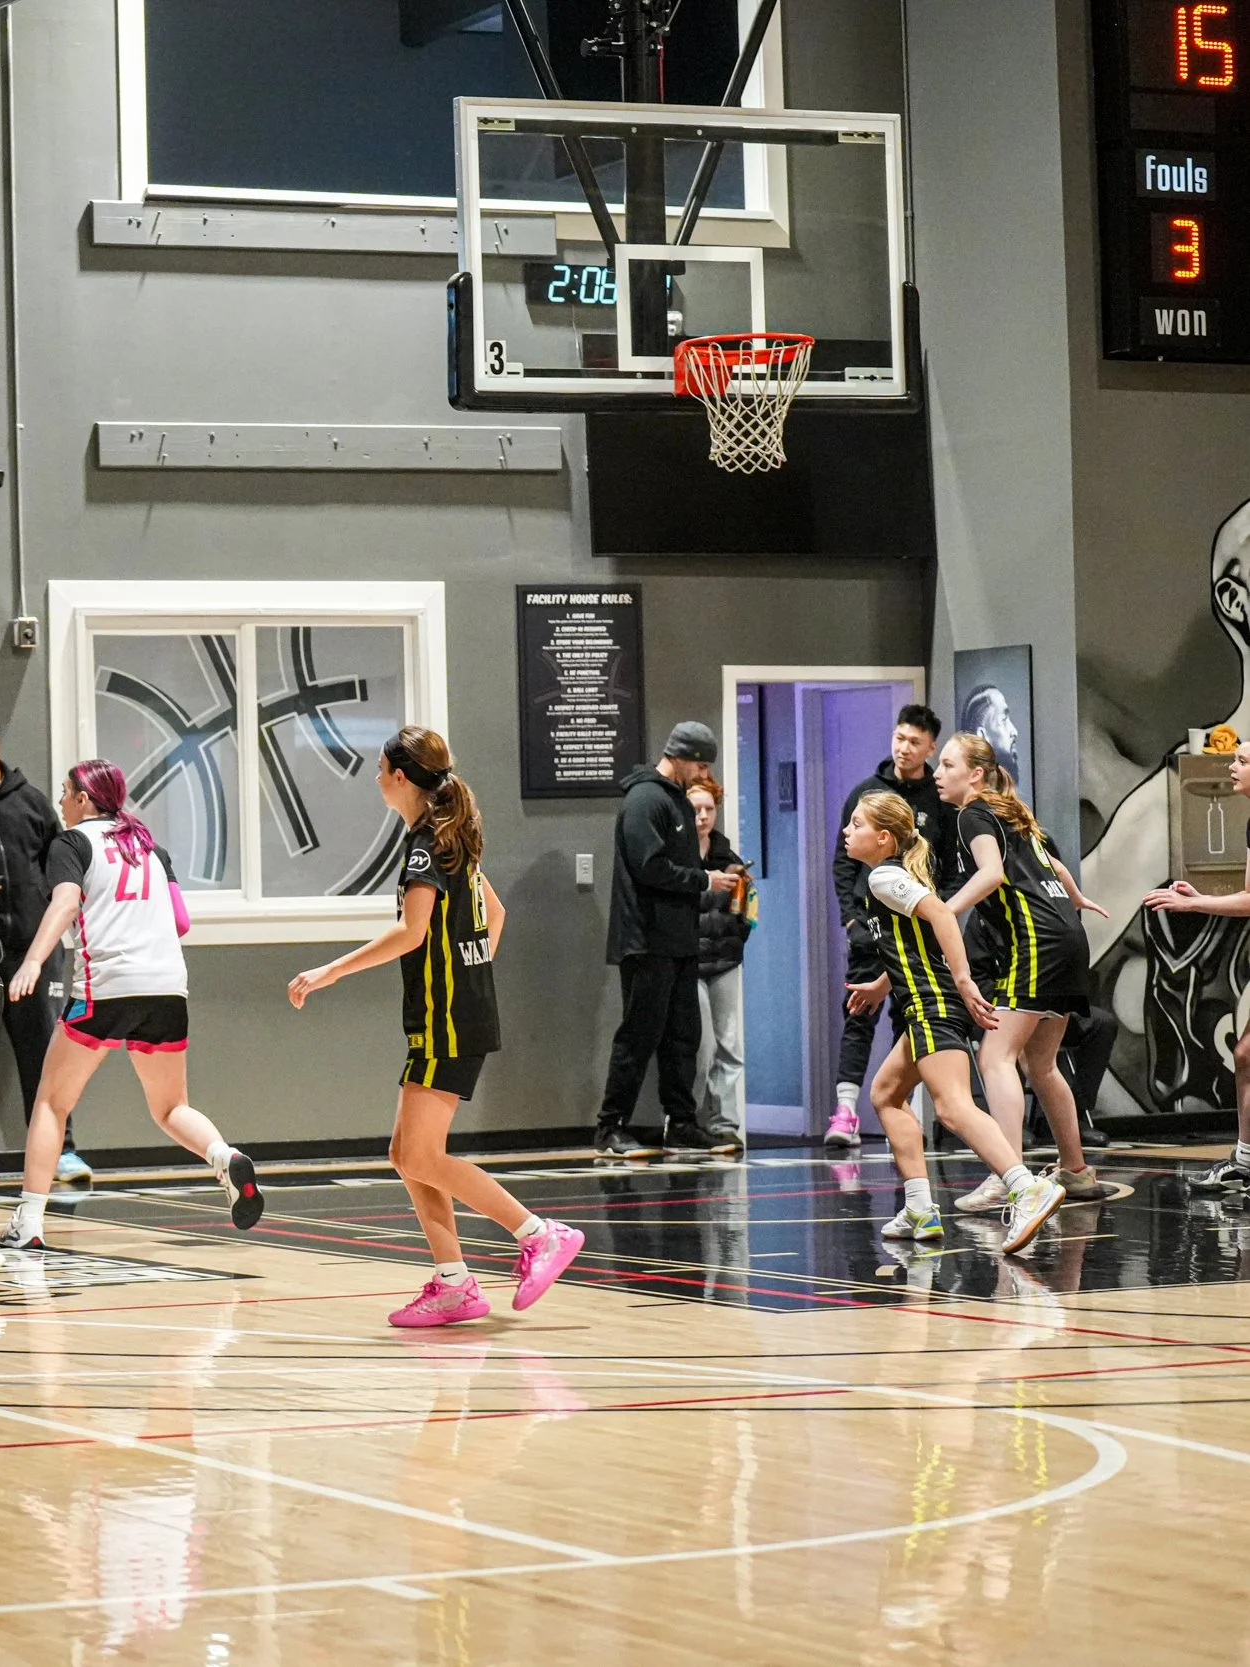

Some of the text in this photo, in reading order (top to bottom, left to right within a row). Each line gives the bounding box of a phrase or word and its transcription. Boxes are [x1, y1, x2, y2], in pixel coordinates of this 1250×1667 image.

[1177, 3, 1234, 86] 15
[1145, 155, 1208, 194] fouls
[1172, 219, 1200, 278] 3
[1155, 308, 1207, 337] won
[489, 341, 504, 375] 3
[526, 594, 568, 605] FACILITY
[569, 593, 600, 605] HOUSE
